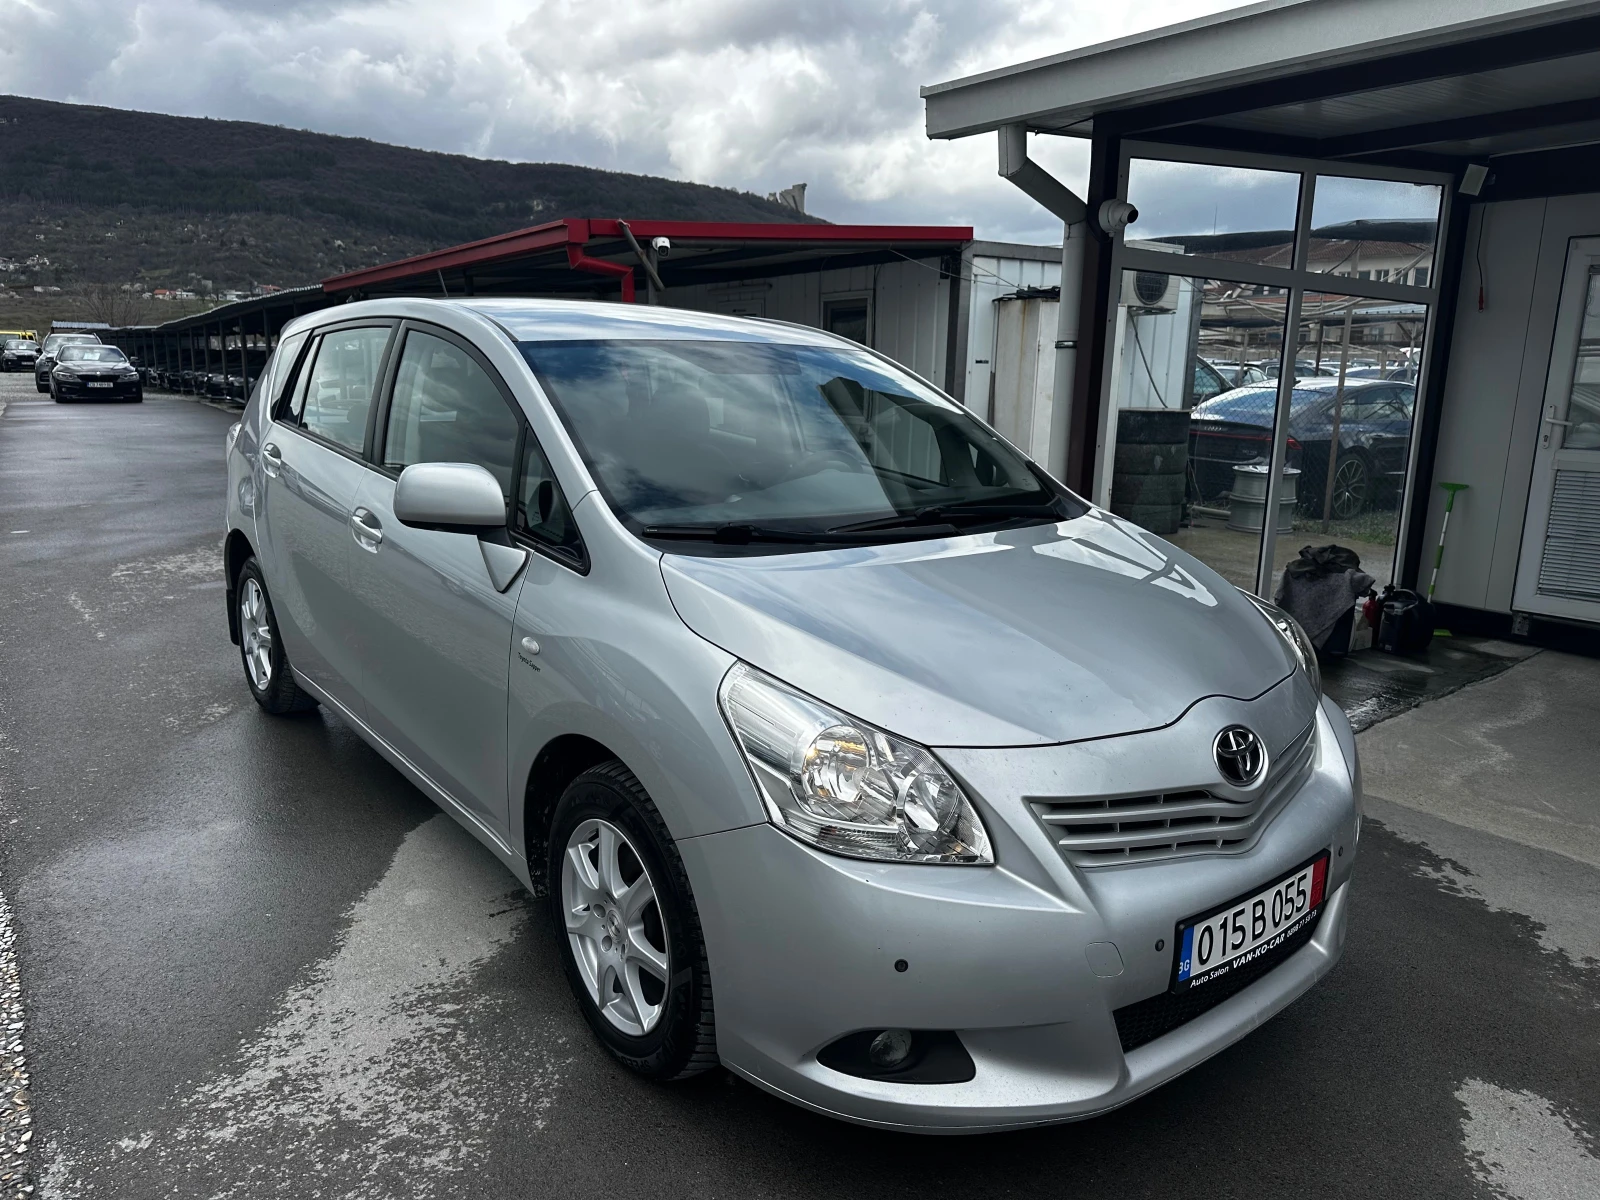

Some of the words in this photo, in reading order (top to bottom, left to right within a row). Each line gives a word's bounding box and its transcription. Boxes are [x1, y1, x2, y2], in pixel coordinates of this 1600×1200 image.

[1189, 975, 1209, 988] Auto
[1209, 965, 1229, 980] Salon
[1232, 932, 1286, 969] VAN-KO-CAR
